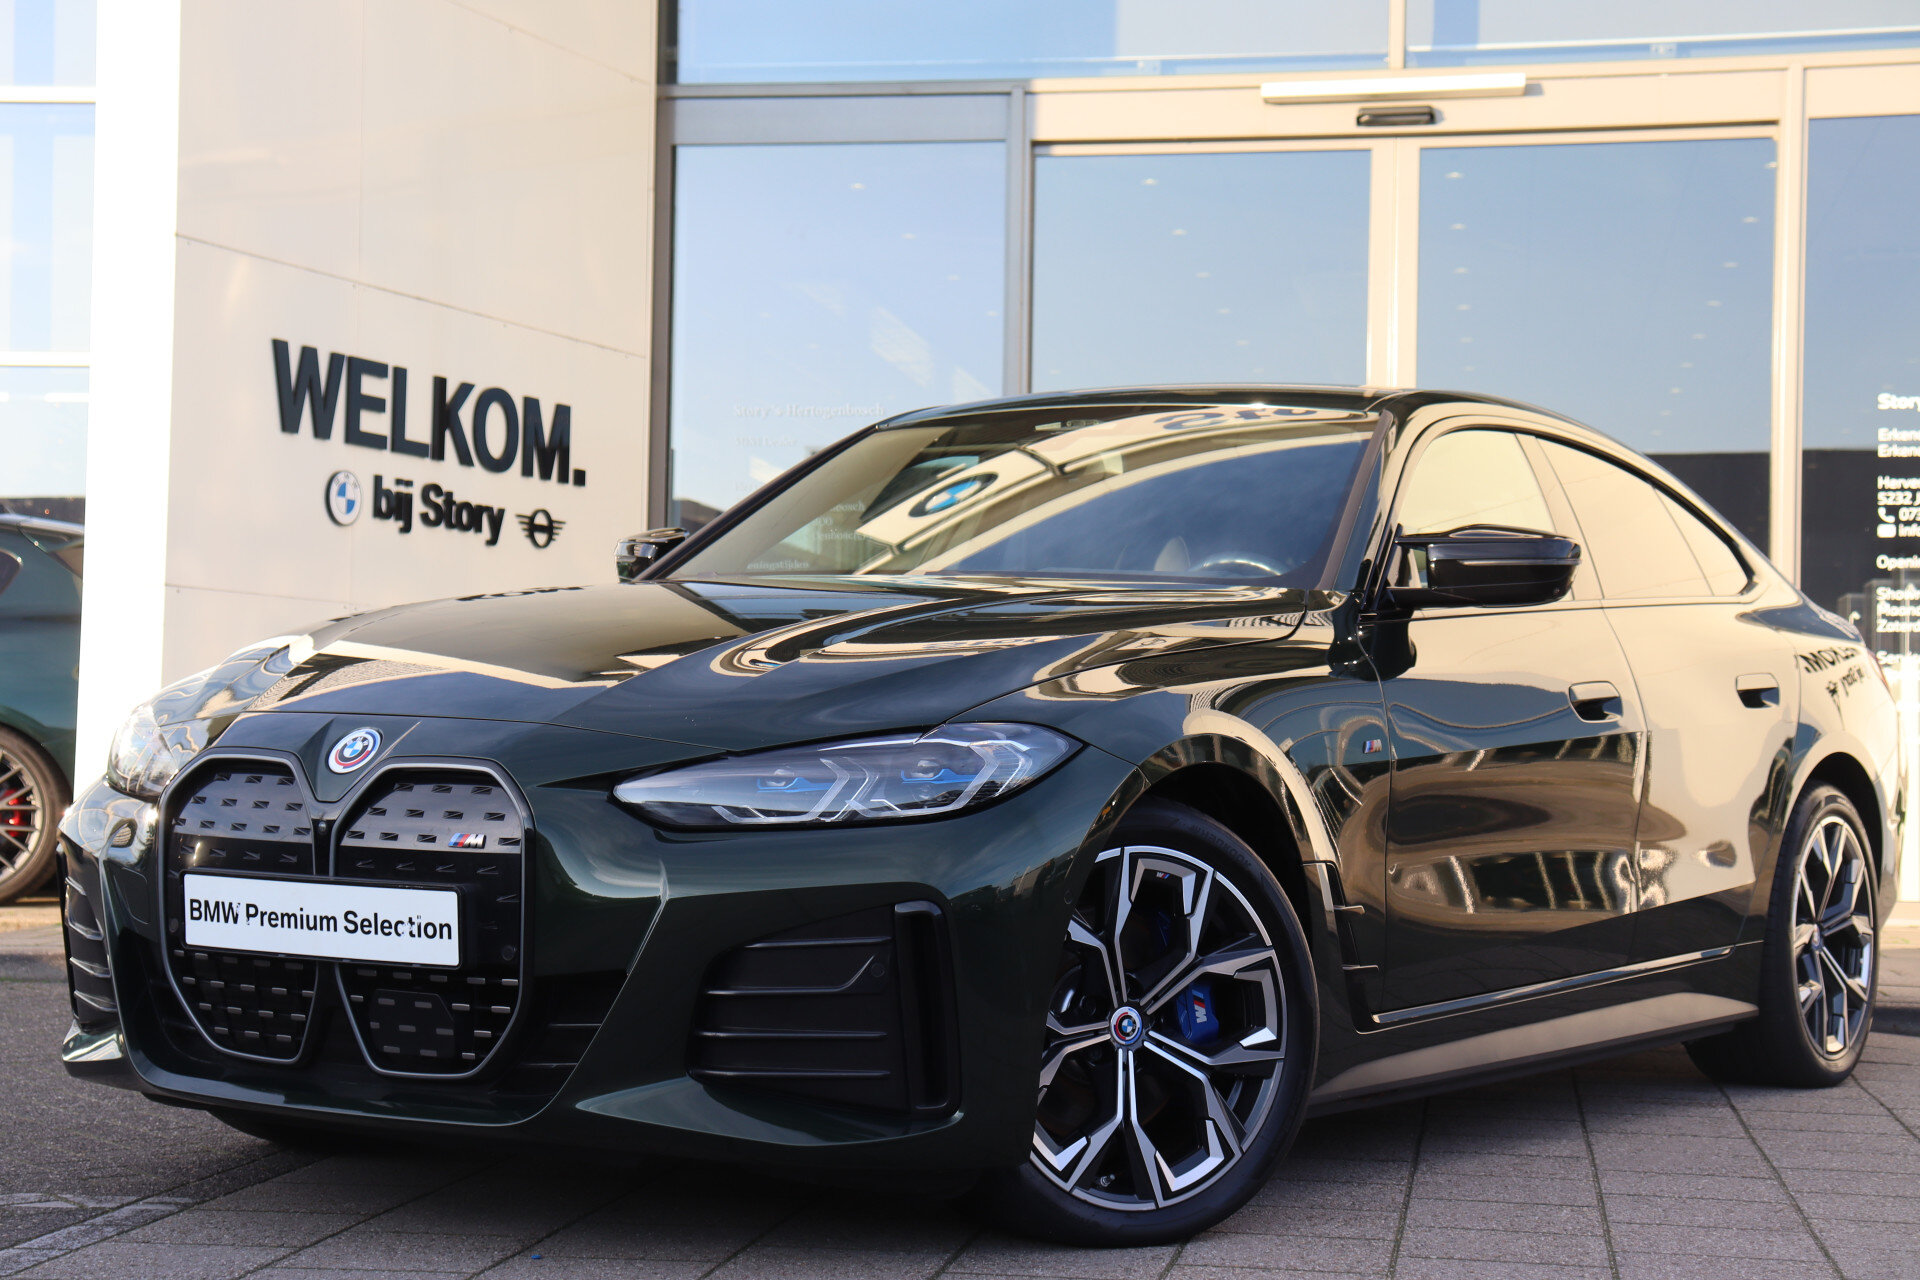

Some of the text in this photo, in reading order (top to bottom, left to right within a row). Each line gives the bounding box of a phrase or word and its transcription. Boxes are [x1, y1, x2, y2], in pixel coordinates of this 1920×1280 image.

[272, 338, 586, 487] WELKOM.
[373, 474, 505, 546] bij Story
[1877, 491, 1912, 506] 5232
[190, 898, 453, 940] BMW Premium Selection
